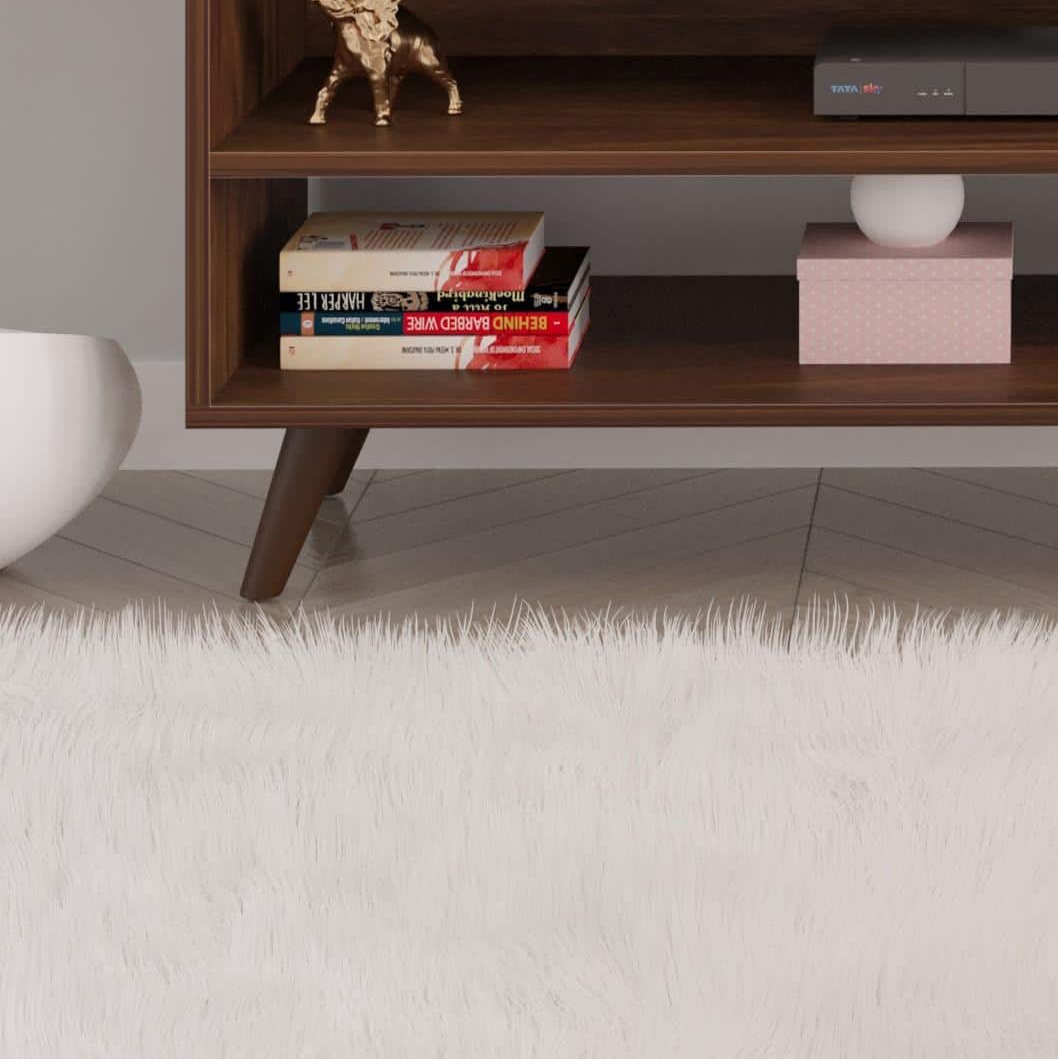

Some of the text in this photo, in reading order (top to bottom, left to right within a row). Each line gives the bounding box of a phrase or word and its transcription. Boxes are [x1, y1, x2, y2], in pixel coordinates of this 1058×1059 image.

[831, 85, 859, 94] TATA
[297, 293, 366, 311] HARPER LEE
[407, 316, 548, 330] BEHIND BARBED WIRE
